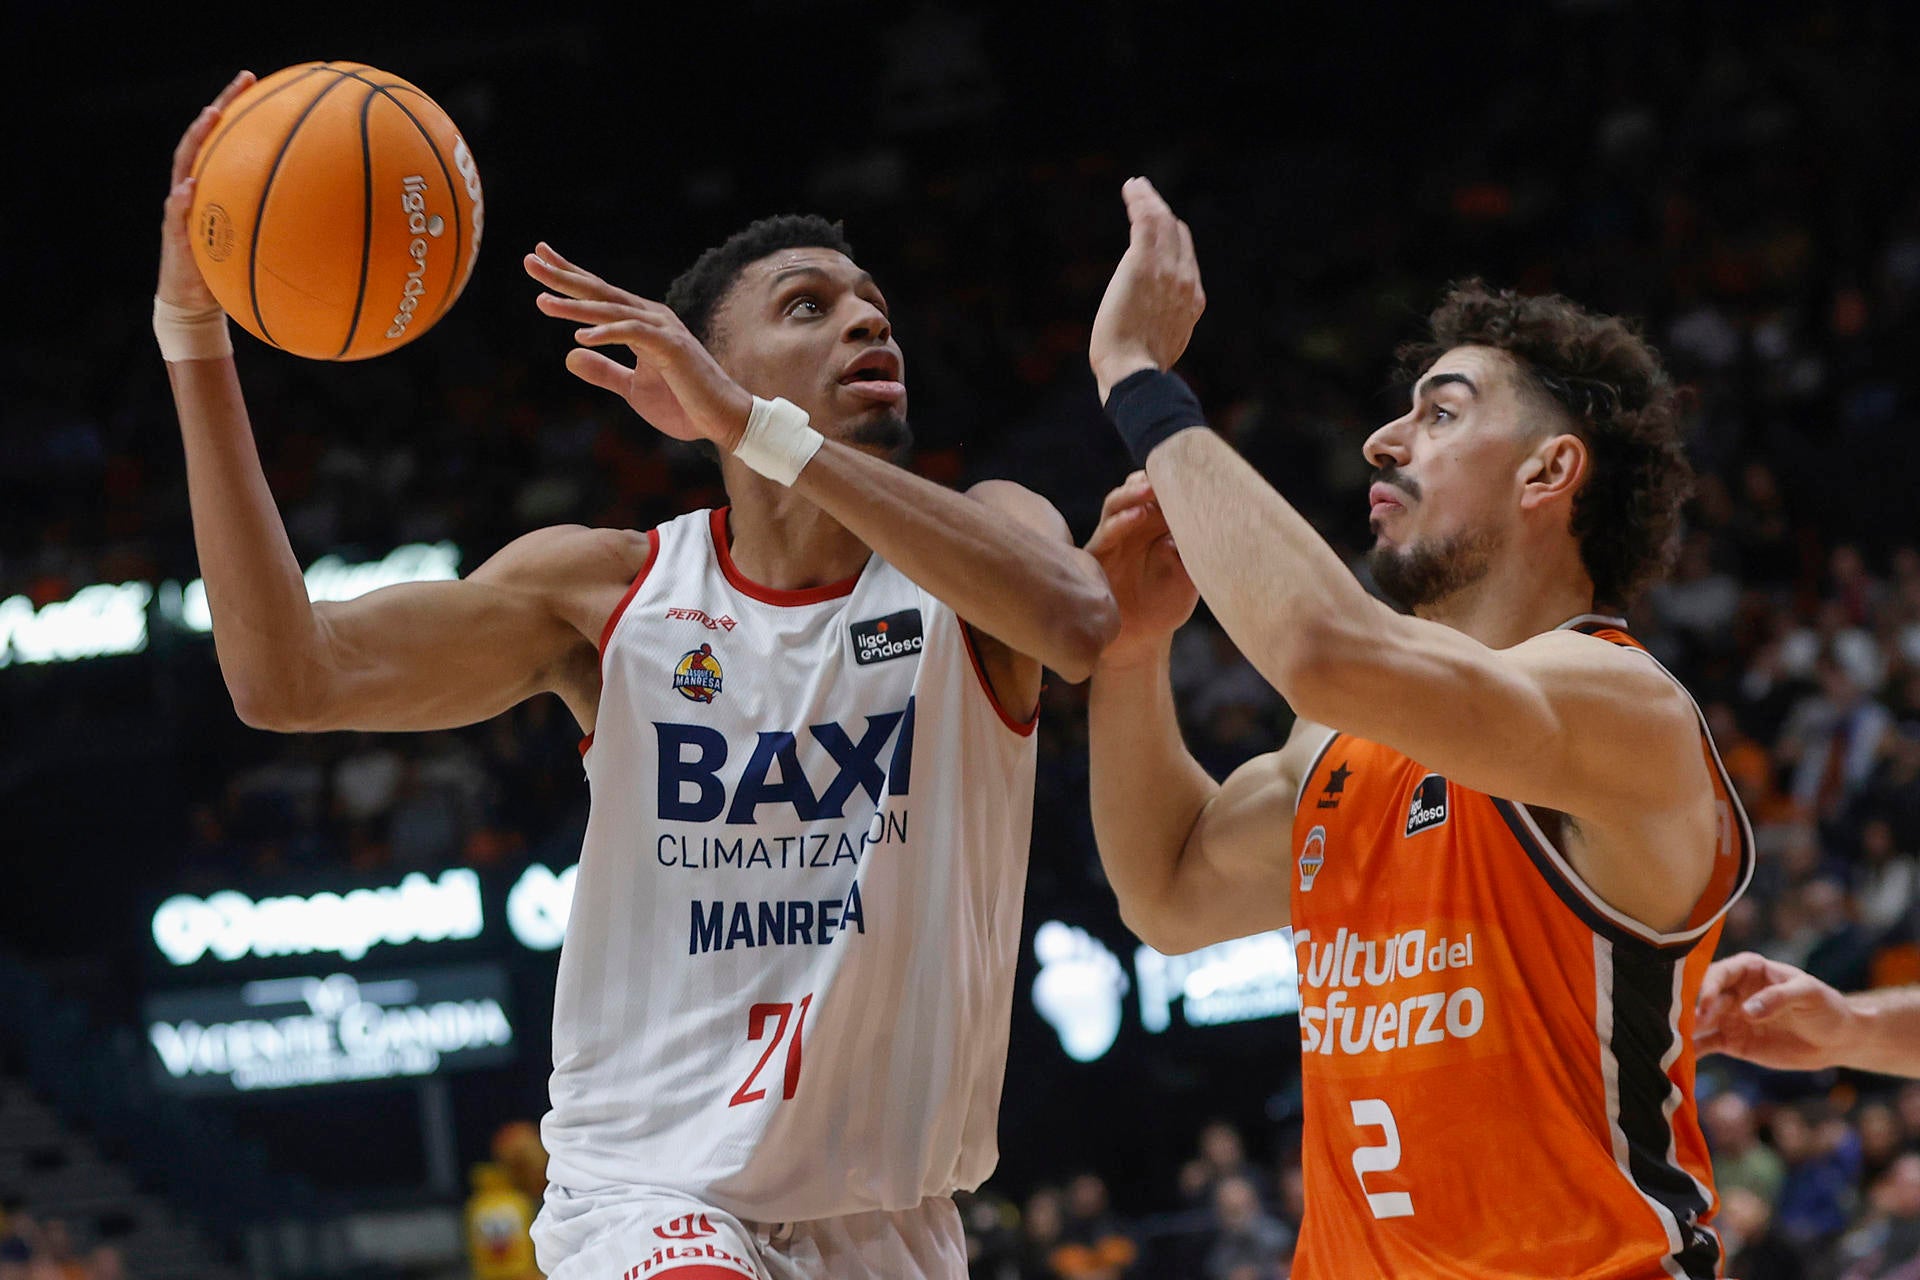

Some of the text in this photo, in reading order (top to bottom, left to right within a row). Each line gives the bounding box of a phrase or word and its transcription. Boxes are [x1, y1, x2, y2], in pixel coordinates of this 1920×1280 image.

[385, 175, 428, 339] liga endesa
[857, 632, 888, 650] liga
[860, 636, 923, 660] endesa
[675, 674, 721, 689] MANRESA
[650, 695, 915, 825] BAXI
[1408, 805, 1445, 829] endesa
[689, 879, 865, 955] MANREA
[1428, 933, 1473, 972] del
[728, 992, 813, 1108] 21
[1299, 987, 1484, 1056] sfuerzo
[1350, 1098, 1415, 1219] 2
